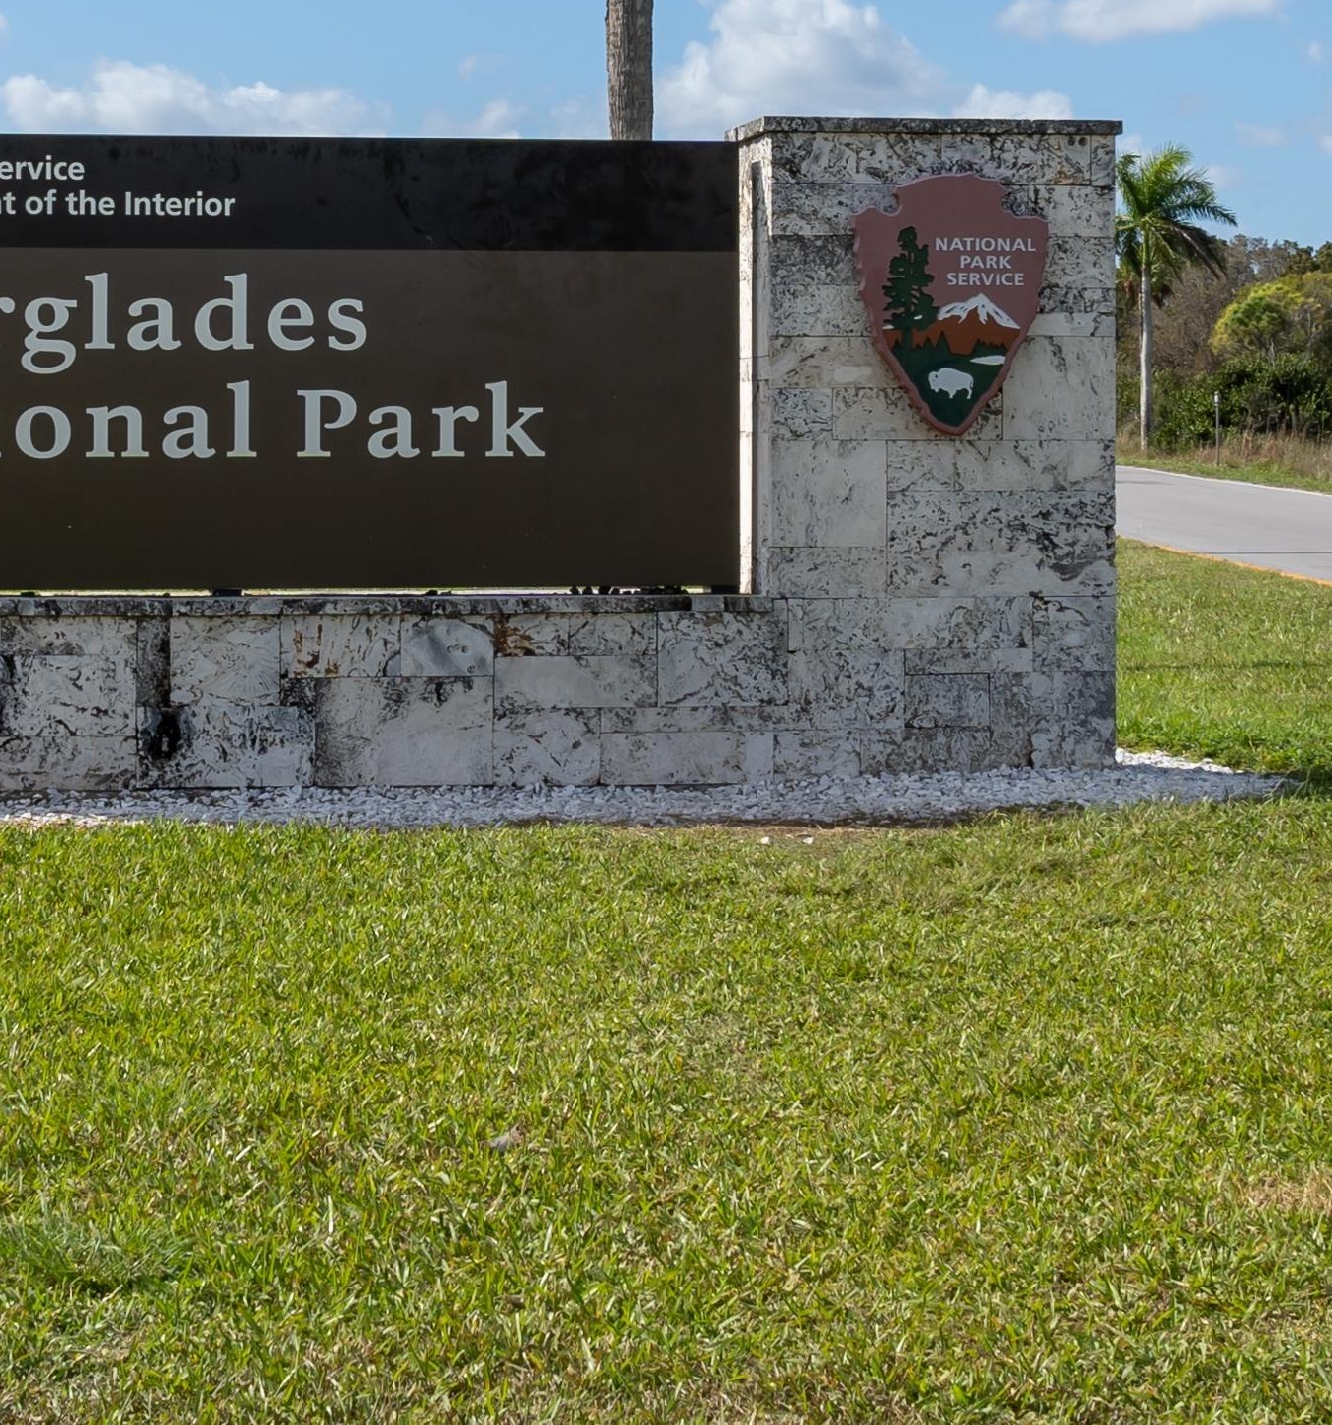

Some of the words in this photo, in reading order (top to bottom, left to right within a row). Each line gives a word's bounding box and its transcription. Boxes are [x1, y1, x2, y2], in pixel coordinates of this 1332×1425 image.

[26, 189, 57, 215] of
[65, 190, 116, 216] the
[125, 191, 236, 217] Interior
[935, 237, 1037, 252] NATIONAL
[960, 255, 1012, 269] PARK
[946, 273, 1025, 286] SERVICE
[297, 380, 546, 459] Park
